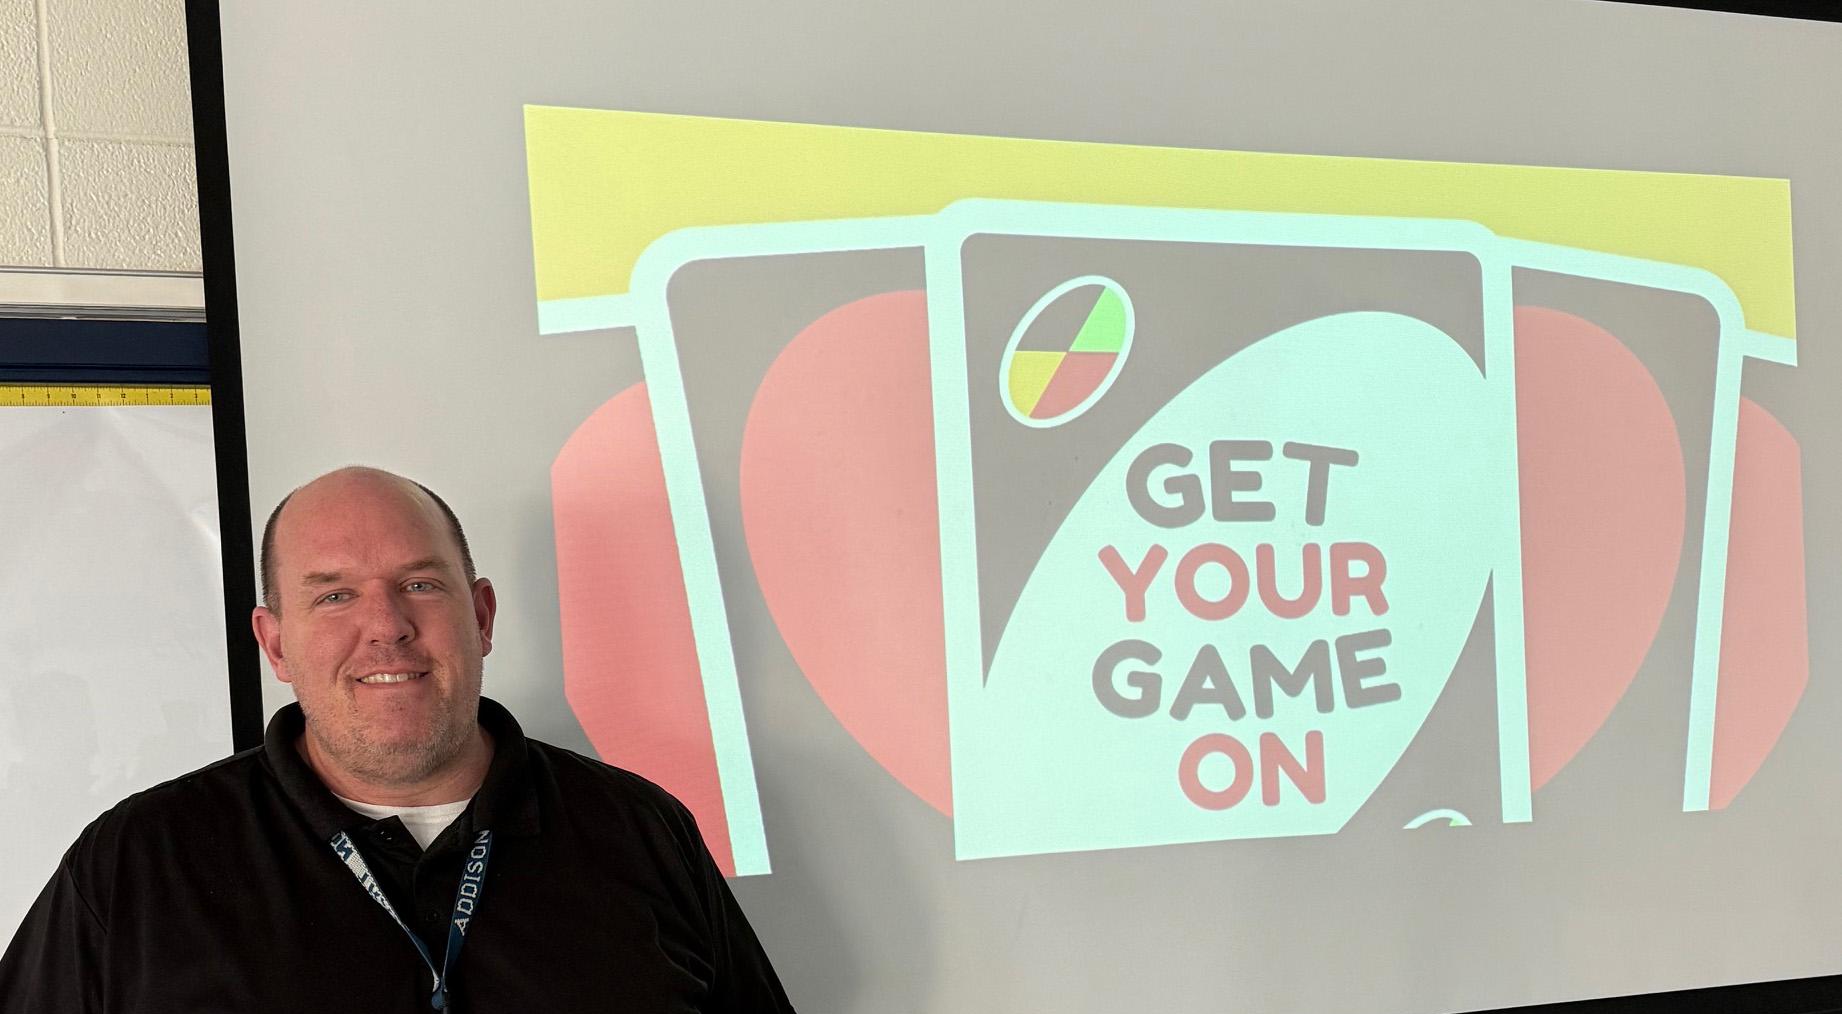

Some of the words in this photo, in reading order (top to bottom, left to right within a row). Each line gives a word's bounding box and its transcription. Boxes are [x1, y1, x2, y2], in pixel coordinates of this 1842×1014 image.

[1125, 439, 1359, 529] GET
[1097, 542, 1390, 623] YOUR
[1091, 628, 1402, 722] GAME
[1178, 729, 1327, 811] ON
[454, 829, 490, 937] ADDISON
